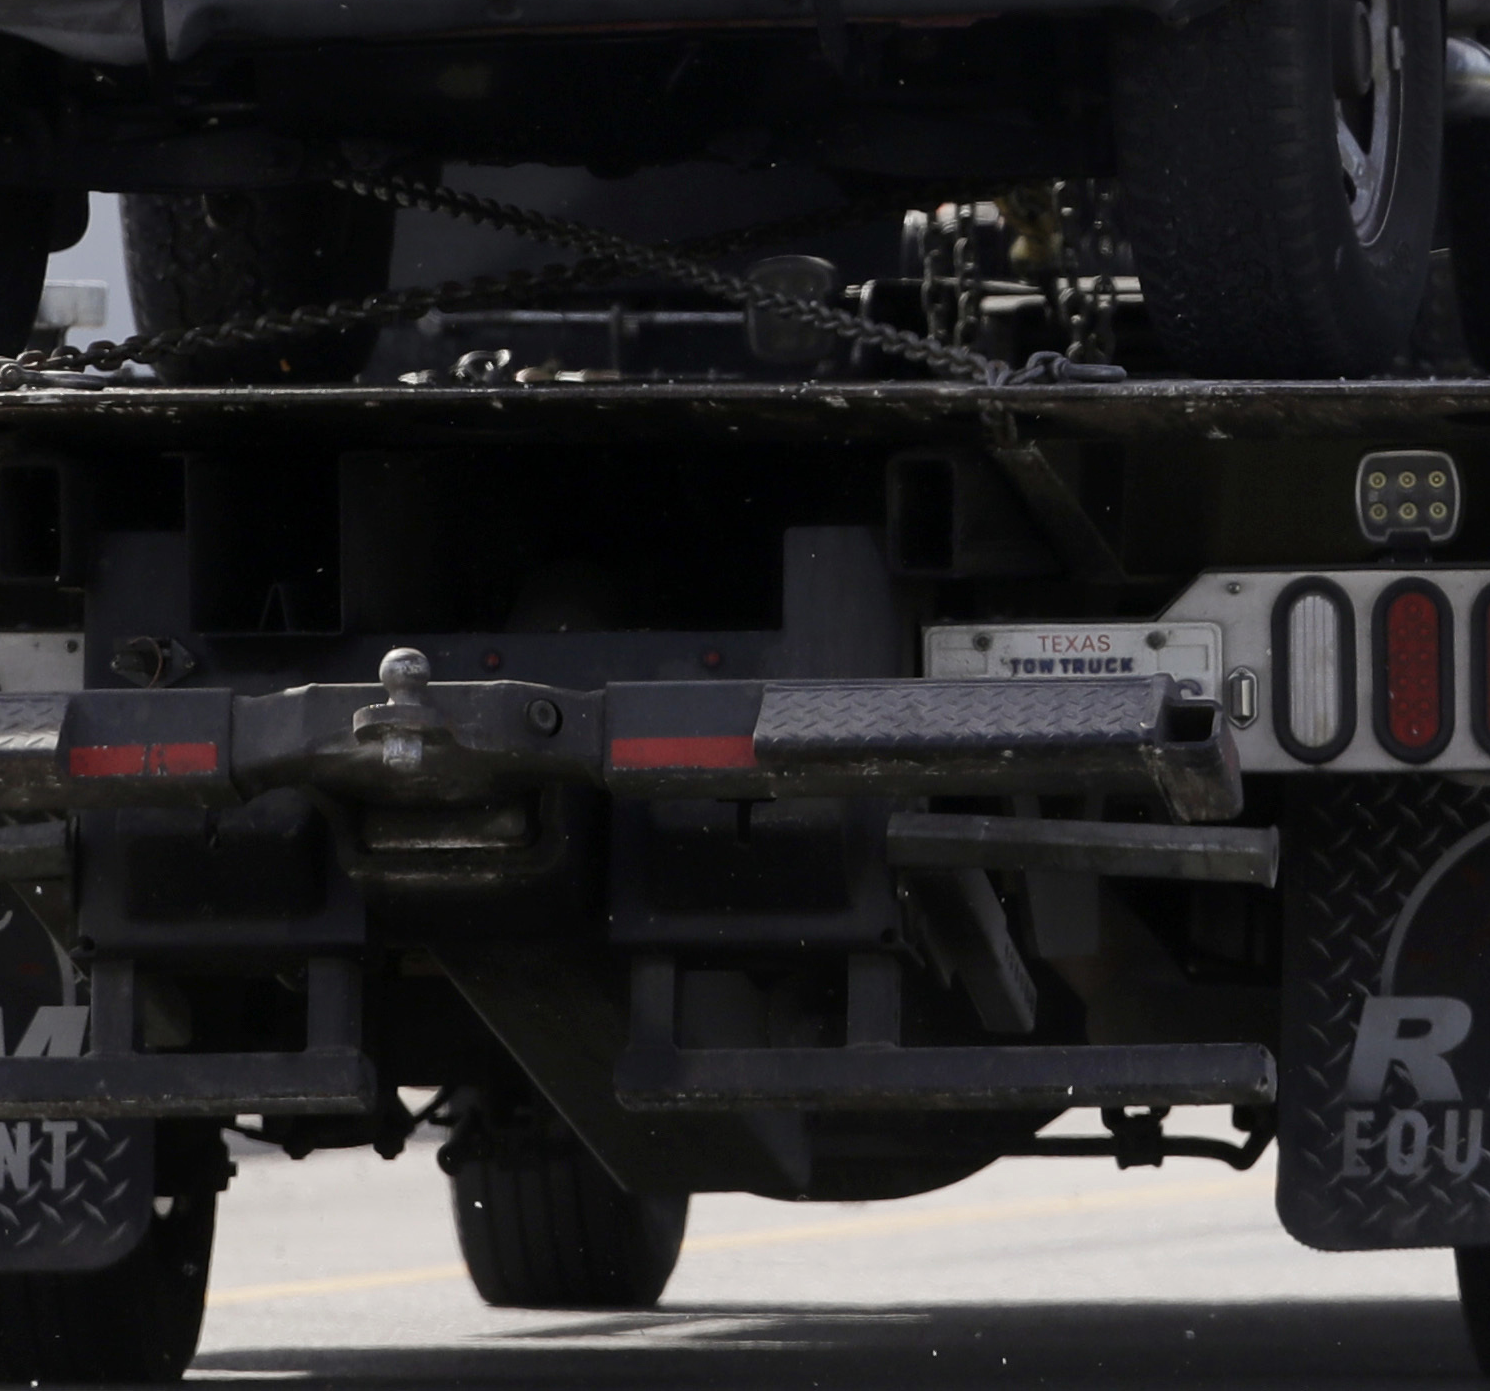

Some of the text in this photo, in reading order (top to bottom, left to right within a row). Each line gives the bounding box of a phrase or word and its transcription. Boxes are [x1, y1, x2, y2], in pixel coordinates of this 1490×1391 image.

[1038, 634, 1111, 652] TEXAS
[1010, 657, 1134, 675] TOW TRUCK
